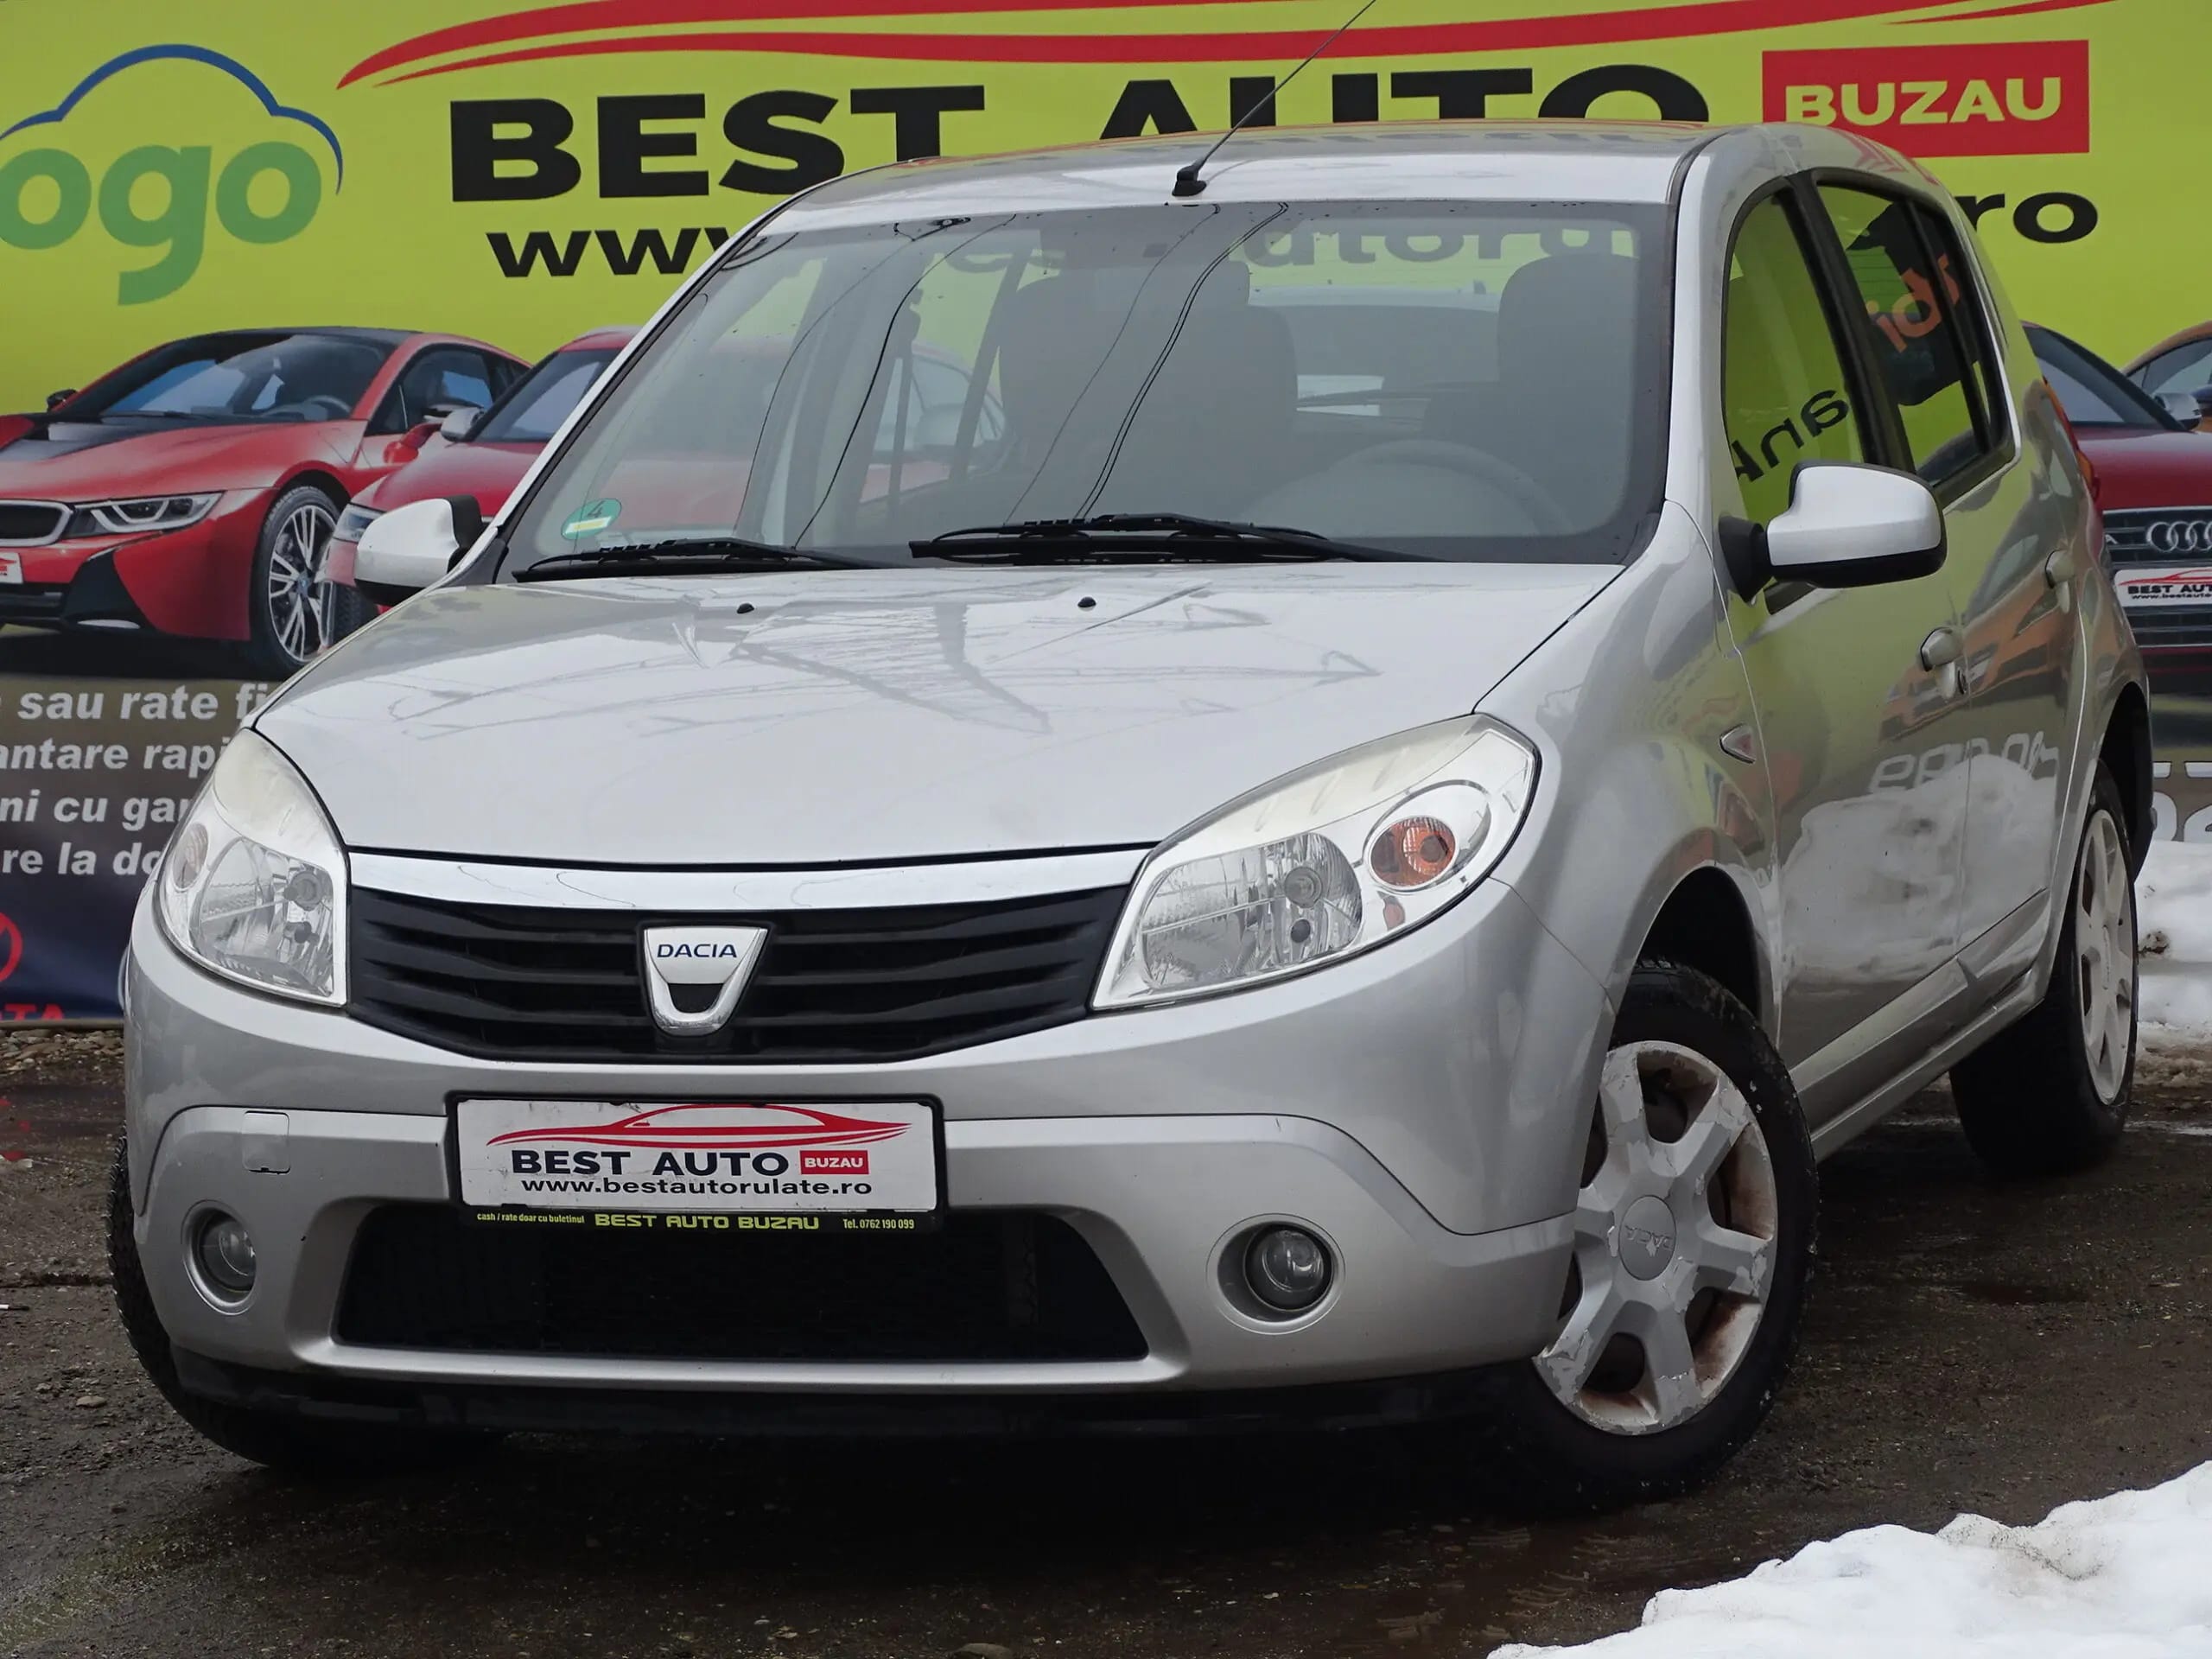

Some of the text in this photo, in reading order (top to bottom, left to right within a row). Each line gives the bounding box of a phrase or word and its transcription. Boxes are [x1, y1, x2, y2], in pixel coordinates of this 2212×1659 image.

[1784, 76, 2063, 127] BUZAU
[450, 85, 985, 201] BEST
[17, 692, 105, 719] sau
[120, 685, 219, 719] rate
[54, 798, 108, 823] cu
[2, 848, 43, 874] re
[57, 842, 97, 875] la
[656, 943, 738, 959] DACIA
[512, 1149, 863, 1176] BEST AUTO BUZAU
[521, 1178, 872, 1196] www.bestautorulate.ro
[477, 1212, 496, 1222] cash
[502, 1213, 518, 1223] rate
[518, 1214, 536, 1223] doar
[549, 1214, 585, 1224] buletinul
[594, 1213, 657, 1227] BEST
[665, 1215, 729, 1229] AUTO
[738, 1216, 819, 1230] BUZAU
[843, 1218, 858, 1230] Tel.
[859, 1219, 880, 1230] 0762
[882, 1219, 896, 1230] 190
[898, 1219, 914, 1230] 099
